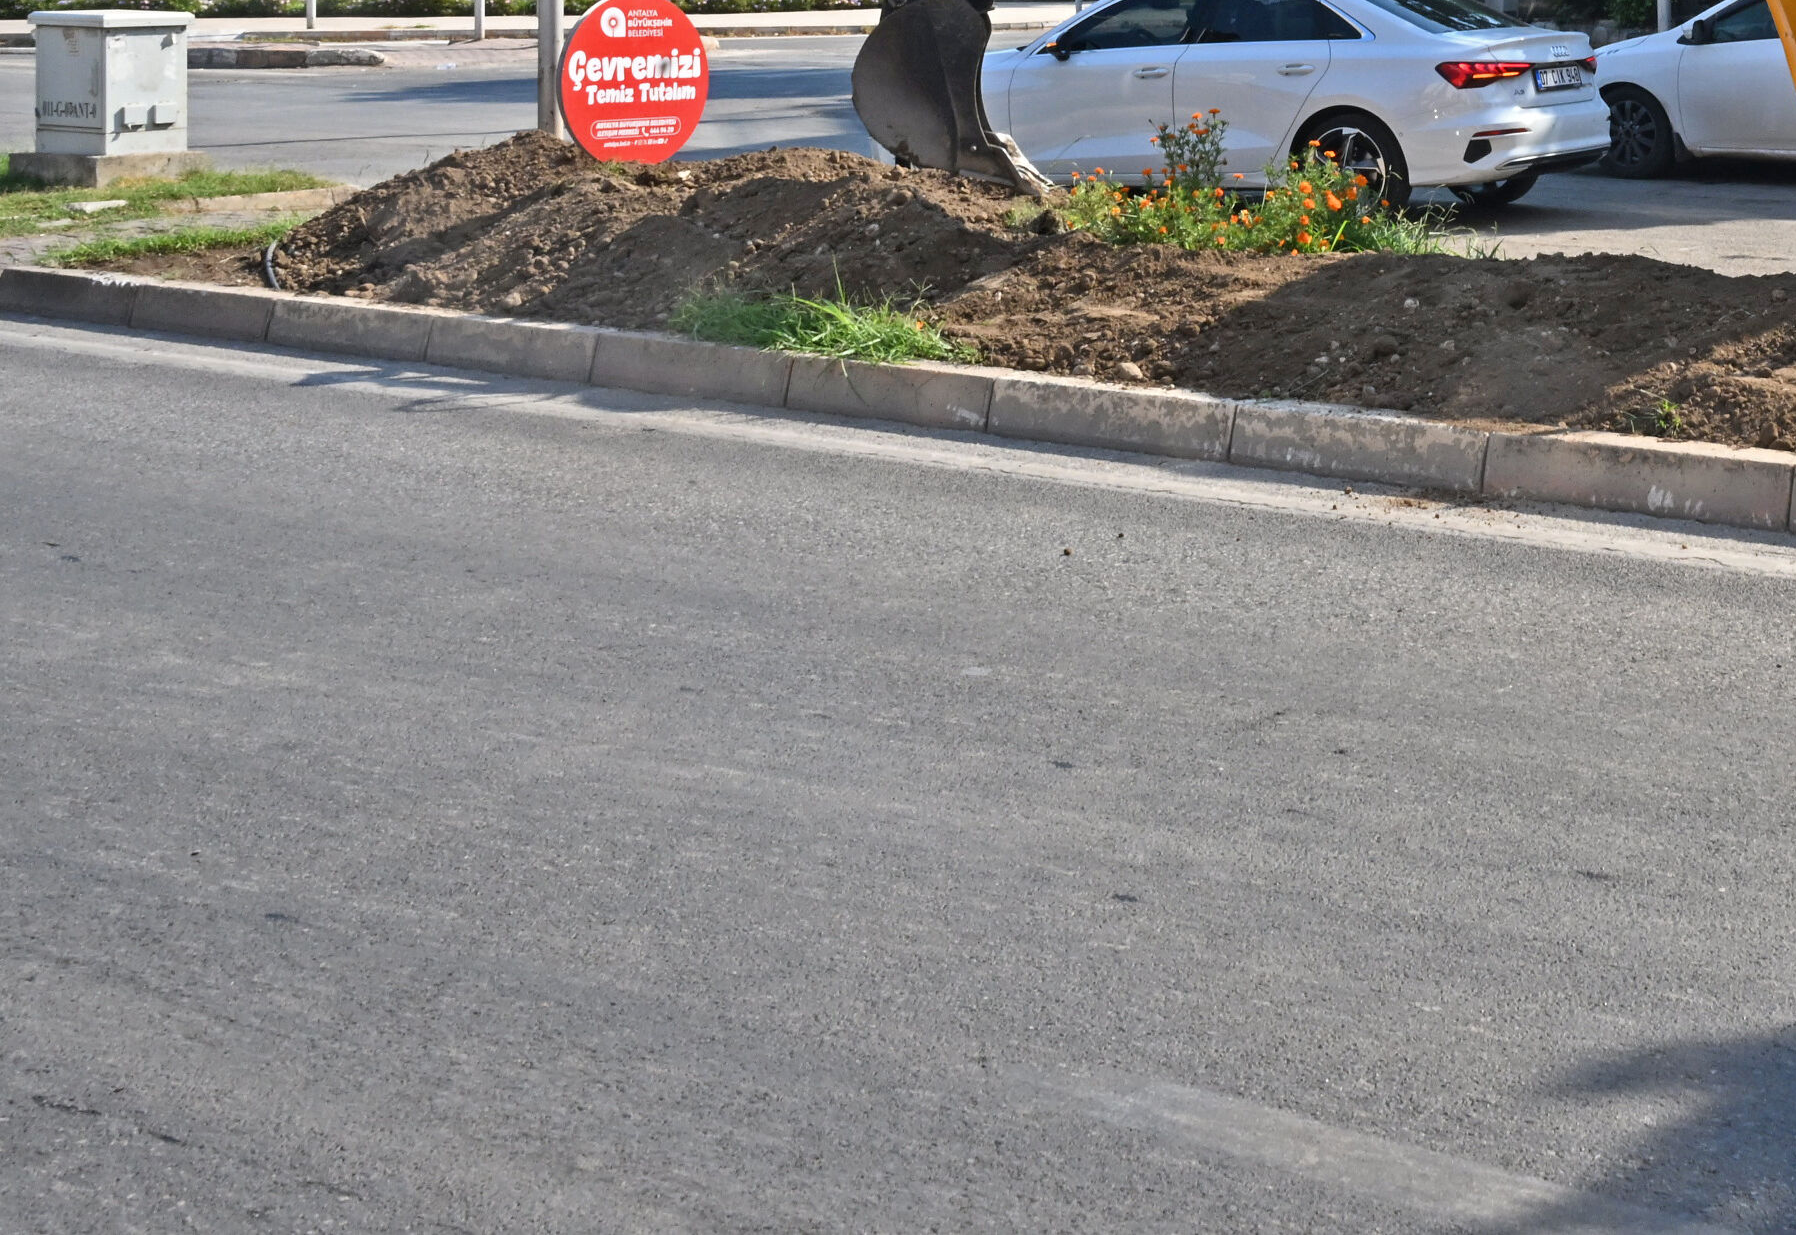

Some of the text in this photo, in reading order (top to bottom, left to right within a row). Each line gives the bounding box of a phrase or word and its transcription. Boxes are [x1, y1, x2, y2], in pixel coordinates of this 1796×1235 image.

[628, 9, 658, 17] ANTALYA
[628, 17, 673, 28] BÜYÜKŞEHİR
[568, 47, 701, 91] Çevremizi
[1540, 70, 1548, 86] 07
[586, 82, 696, 105] Temiz Tutalım
